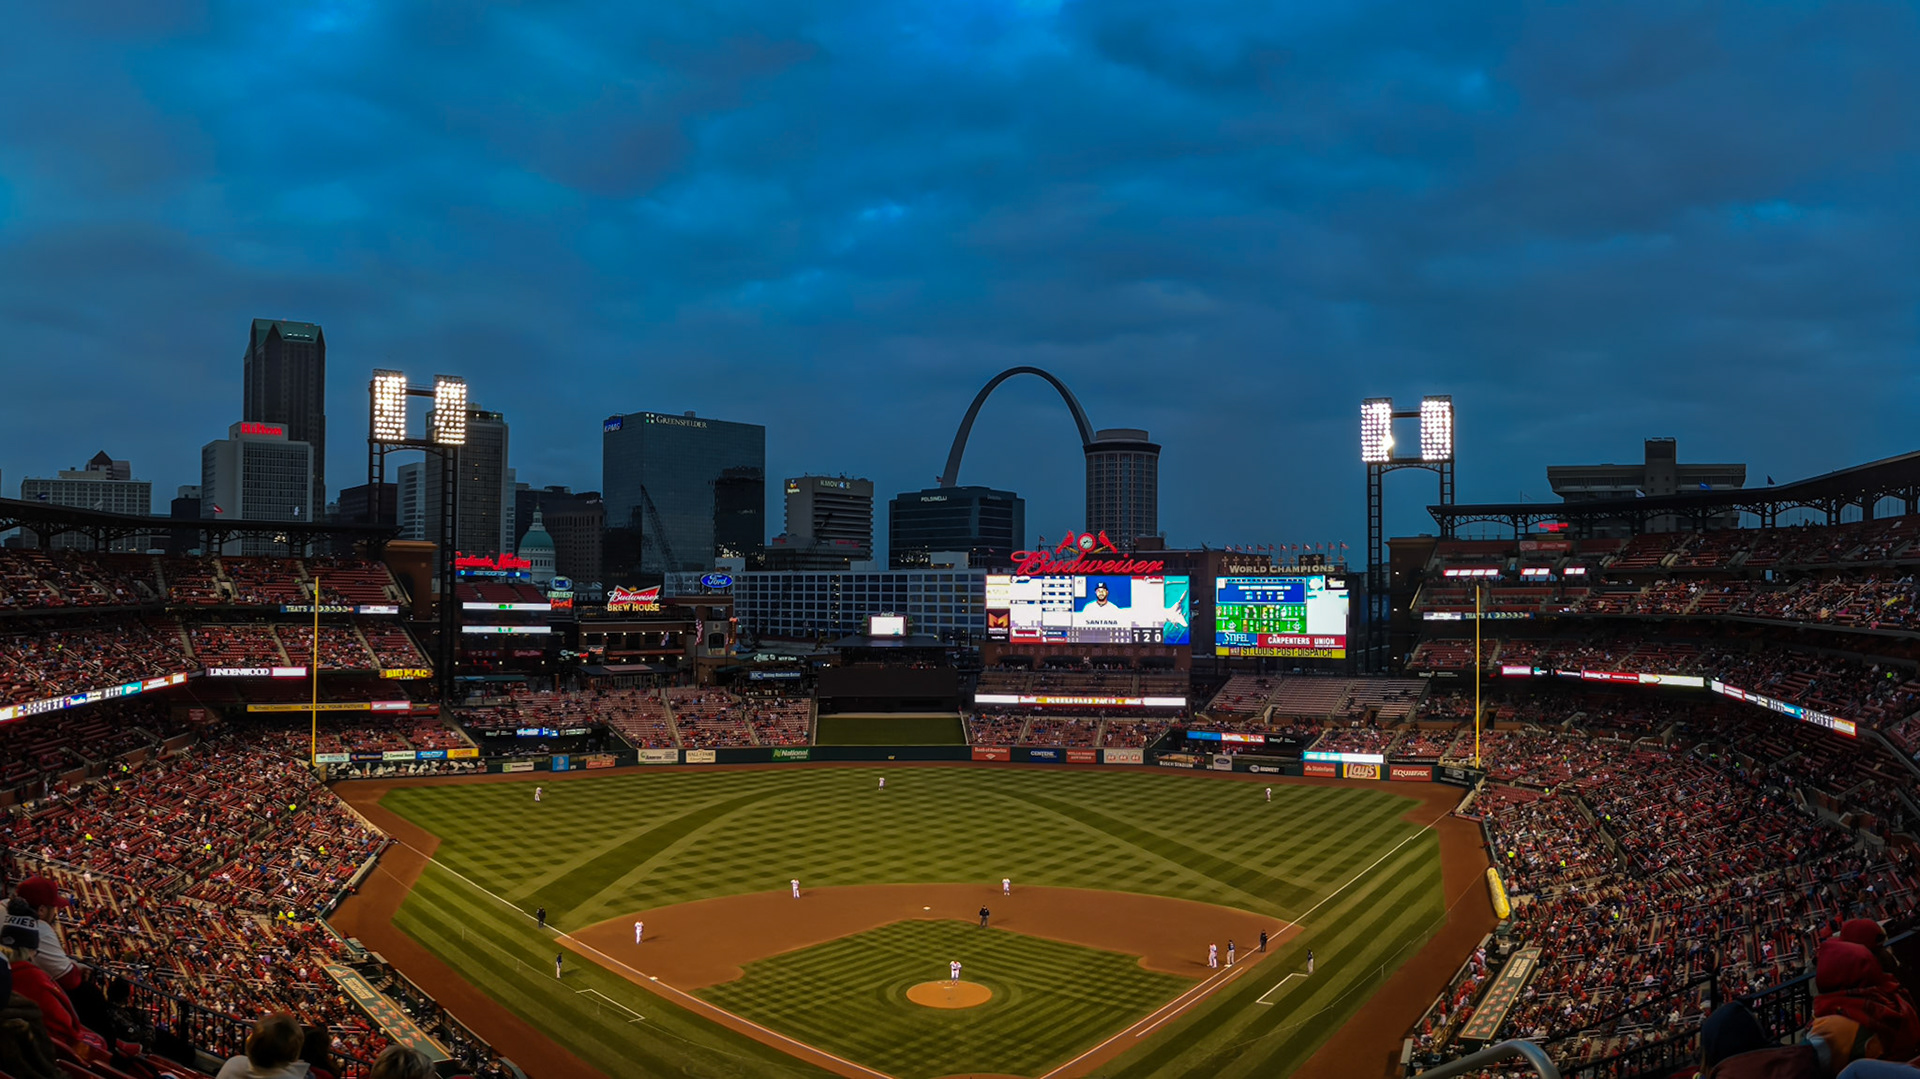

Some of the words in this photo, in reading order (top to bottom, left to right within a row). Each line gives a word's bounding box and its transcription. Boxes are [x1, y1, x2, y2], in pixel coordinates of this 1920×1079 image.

[656, 415, 708, 428] GREENSFELDER
[241, 423, 282, 436] Hilton
[604, 422, 620, 432] KPMG
[820, 480, 837, 488] KMOV
[1010, 550, 1164, 575] Budweiser
[1229, 564, 1267, 573] WORLD
[1269, 564, 1335, 573] CHAMPIONS
[707, 574, 728, 585] Ford
[607, 590, 659, 602] Budweiser
[607, 603, 631, 612] BREW
[632, 603, 660, 612] HOUSE
[1133, 634, 1138, 642] 1
[1143, 634, 1150, 642] 2
[1155, 634, 1161, 642] 0
[1224, 634, 1249, 642] STIFEL
[1268, 637, 1310, 645] CARPENTERS
[1276, 648, 1332, 657] POST-DISPATCH
[210, 668, 269, 676] LINDENWOOD
[386, 669, 403, 678] BIG
[404, 669, 428, 677] MAC
[781, 749, 809, 757] National
[1393, 769, 1429, 777] EQUIFAX
